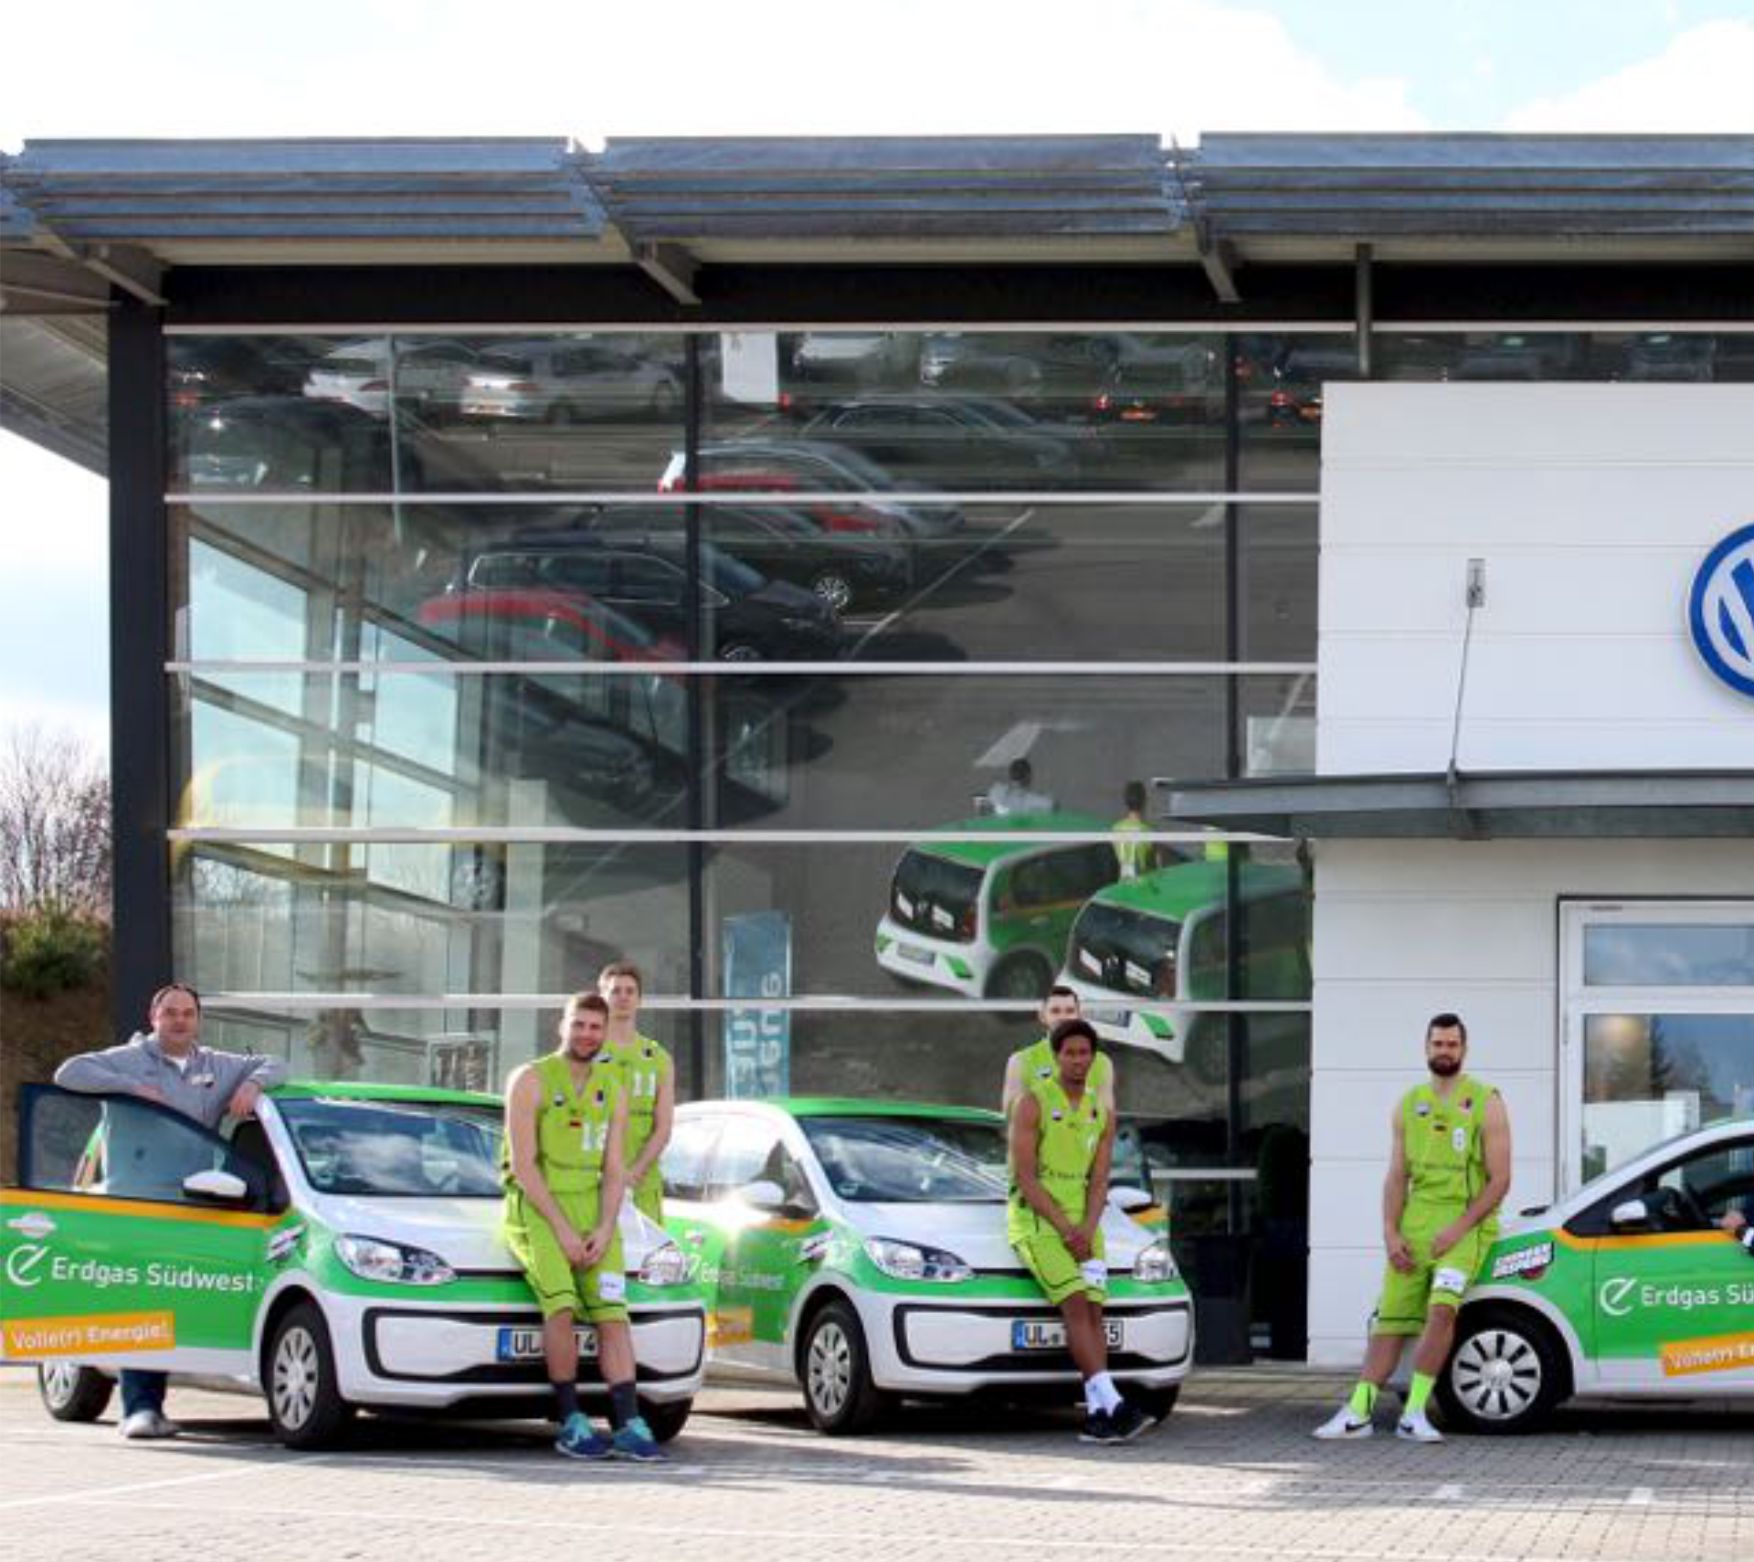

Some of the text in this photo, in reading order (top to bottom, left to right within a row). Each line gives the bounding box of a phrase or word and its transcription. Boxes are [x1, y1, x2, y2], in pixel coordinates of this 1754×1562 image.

[52, 1256, 139, 1288] Erdgas
[146, 1262, 254, 1292] Südwest
[1640, 1284, 1719, 1309] Erdgas
[514, 1333, 542, 1354] UL
